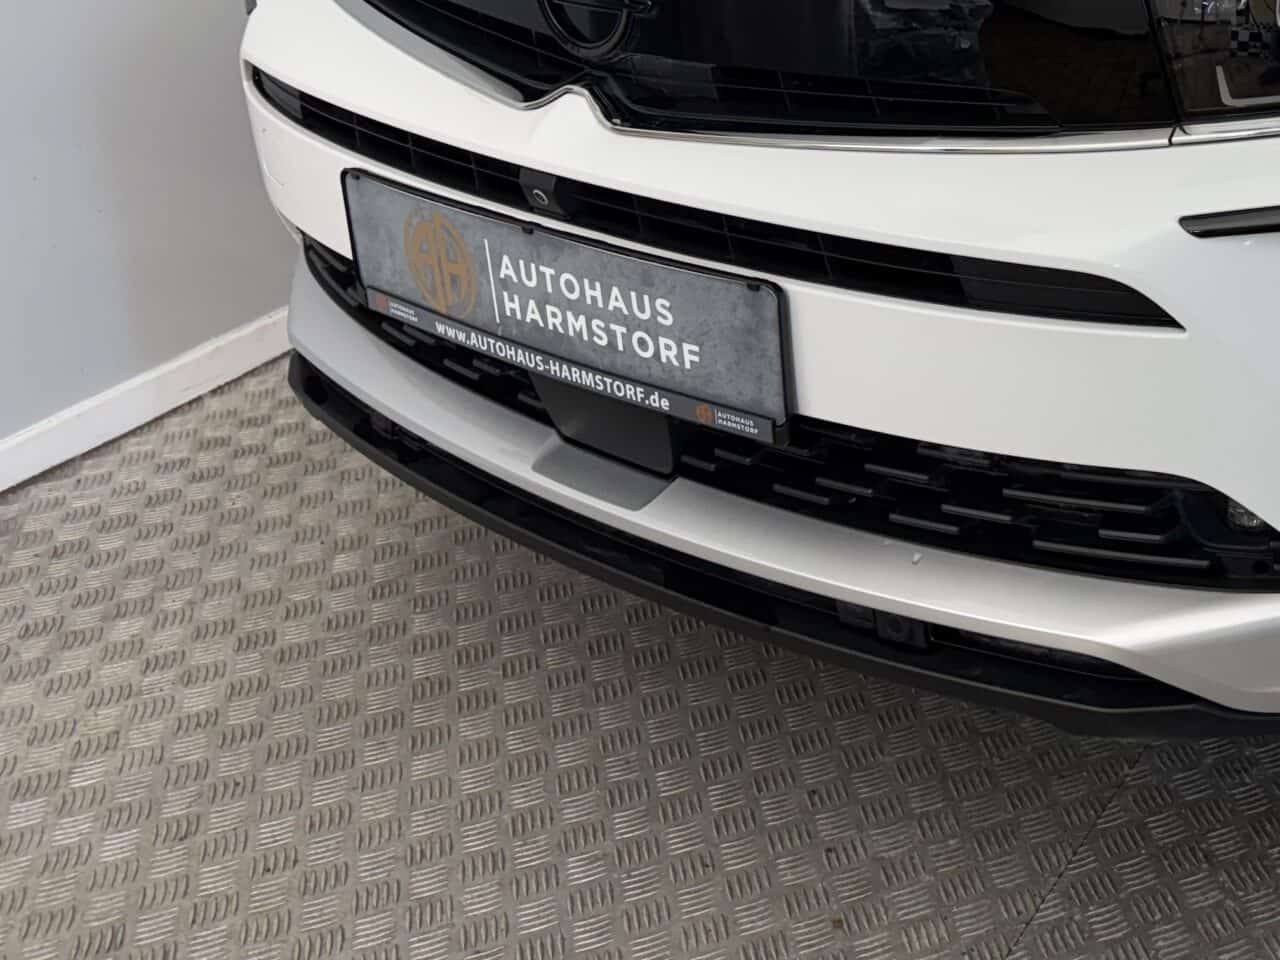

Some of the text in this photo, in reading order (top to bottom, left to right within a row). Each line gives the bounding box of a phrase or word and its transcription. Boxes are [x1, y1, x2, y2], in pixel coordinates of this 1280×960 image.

[499, 254, 674, 327] AUTOHAUS
[502, 290, 700, 369] HARMSTORF
[435, 321, 670, 411] www.AUTOHAUS-HARMSTORF.de
